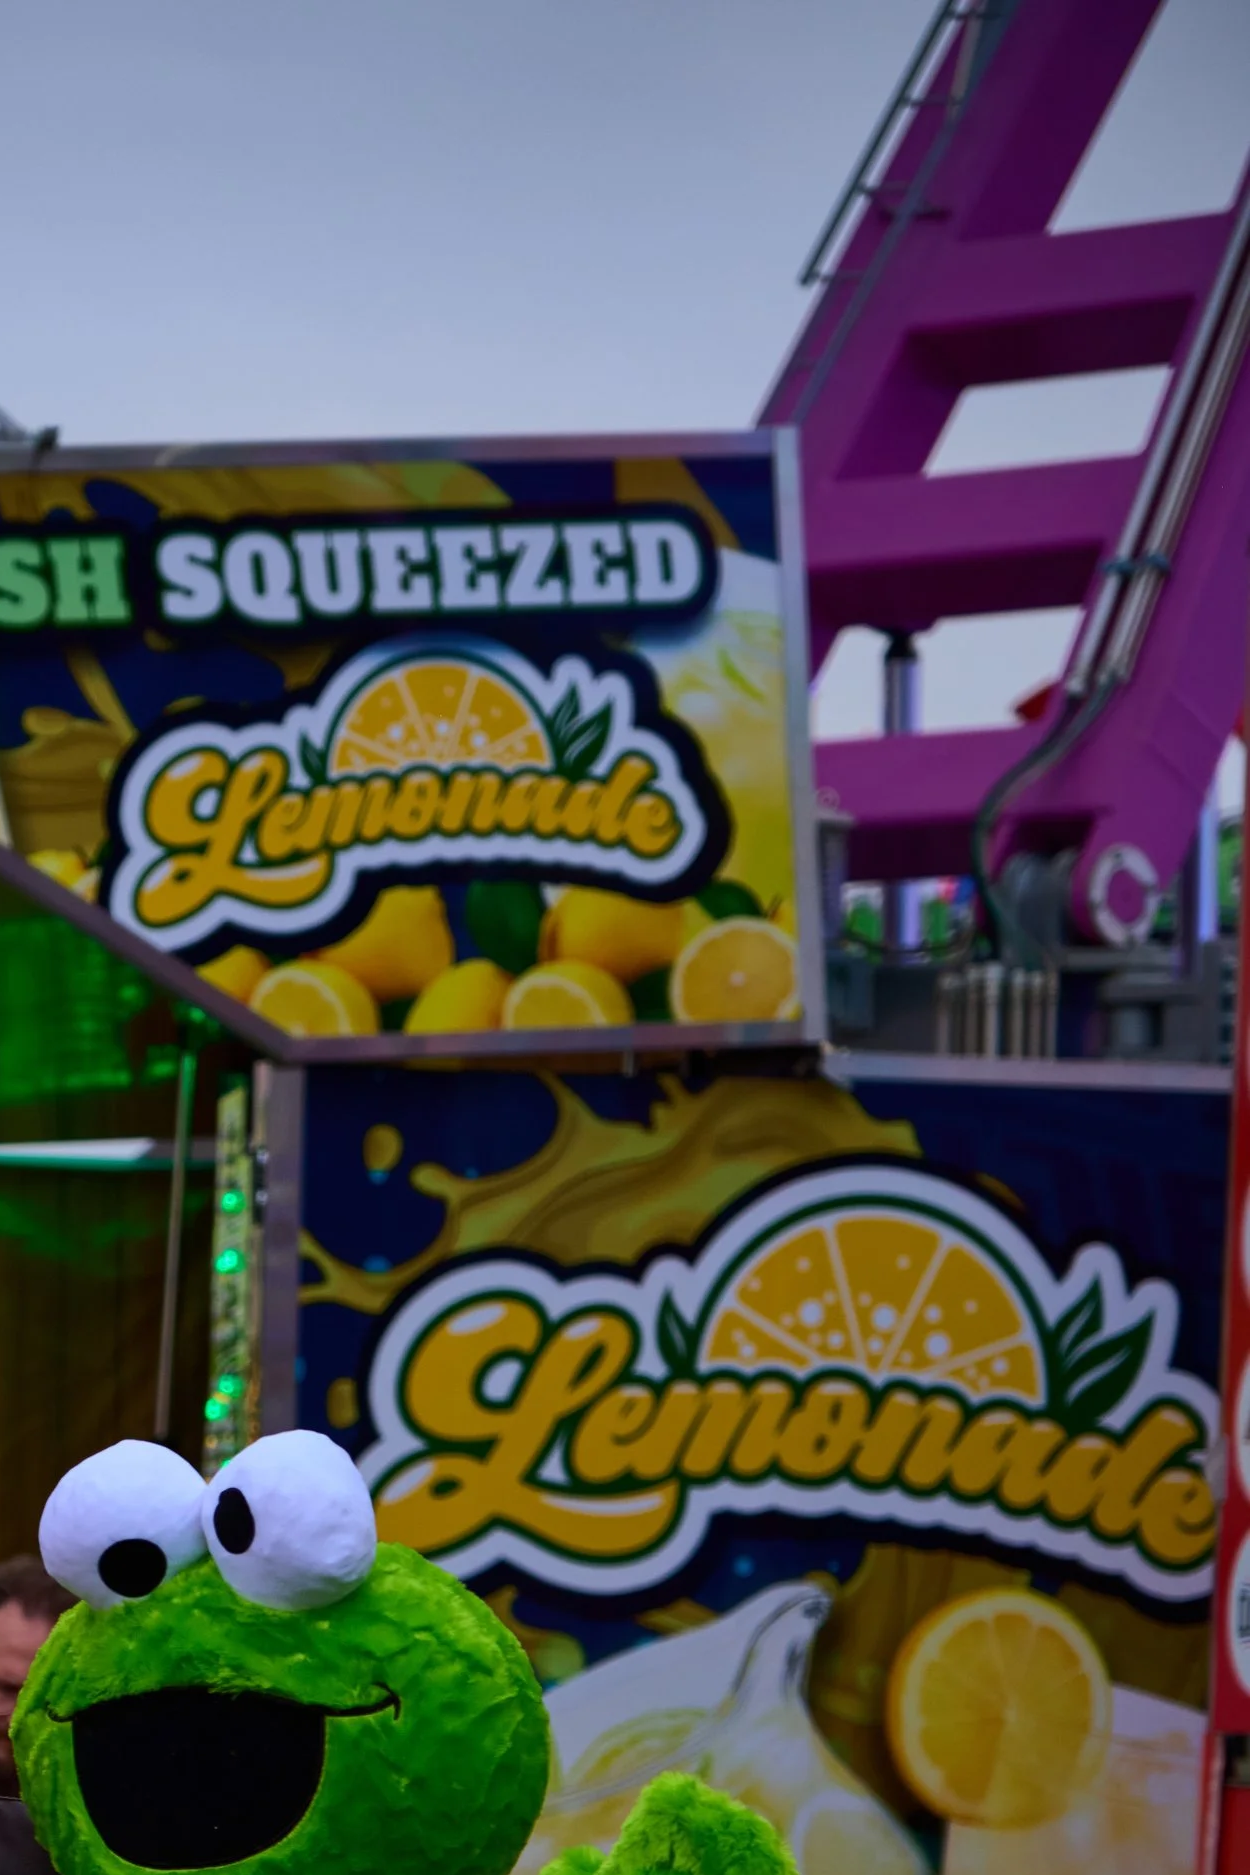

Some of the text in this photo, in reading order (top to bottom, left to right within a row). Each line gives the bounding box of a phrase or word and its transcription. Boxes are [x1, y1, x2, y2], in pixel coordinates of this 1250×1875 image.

[158, 521, 702, 627] SQUEEZED
[137, 746, 684, 926] Lemonade
[375, 1296, 1216, 1568] Lemonade
